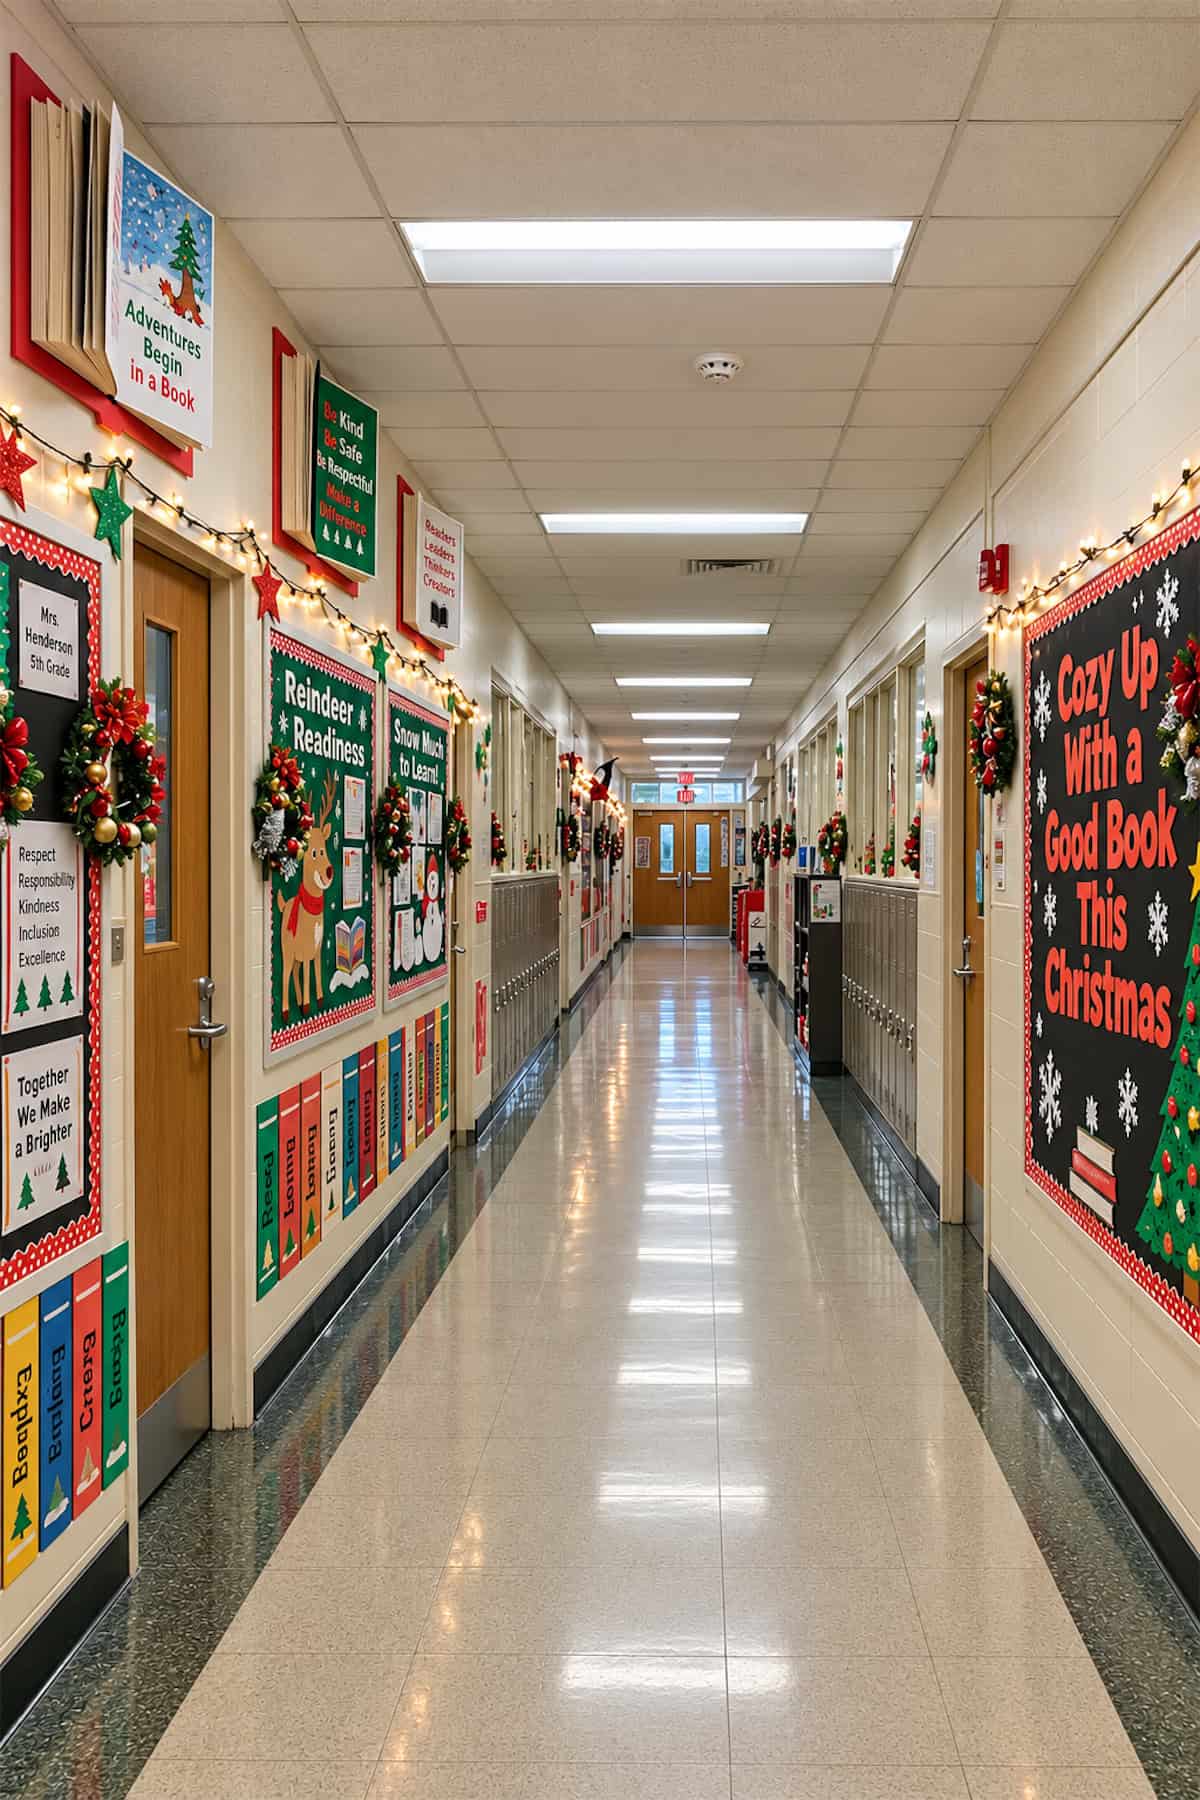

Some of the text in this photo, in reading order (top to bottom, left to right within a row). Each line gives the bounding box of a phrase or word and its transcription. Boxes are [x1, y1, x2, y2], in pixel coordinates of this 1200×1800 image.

[124, 299, 202, 360] Adventures
[143, 336, 183, 376] Begin
[130, 358, 196, 412] in a Book
[324, 400, 364, 440] Be Kind
[324, 428, 363, 465] Be Safe
[327, 456, 373, 496] Respectful
[40, 605, 60, 627] Mrs.
[25, 626, 74, 656] Henderson
[30, 654, 71, 679] 5th Grade
[1057, 624, 1158, 722] Cozy Up
[284, 669, 354, 726] Reindeer
[293, 716, 365, 768] Readiness
[394, 717, 444, 761] Snow Much
[1064, 718, 1143, 797] With a
[399, 752, 410, 777] to
[1044, 787, 1178, 873] Good Book
[19, 846, 56, 866] Respect
[19, 897, 60, 915] Kindness
[1076, 877, 1128, 952] This
[19, 923, 60, 942] Inclusion
[19, 949, 66, 968] Excellence
[1044, 946, 1172, 1049] Christmas
[17, 1067, 69, 1098] Together
[17, 1094, 71, 1129] We Make
[15, 1123, 73, 1159] a Brighter
